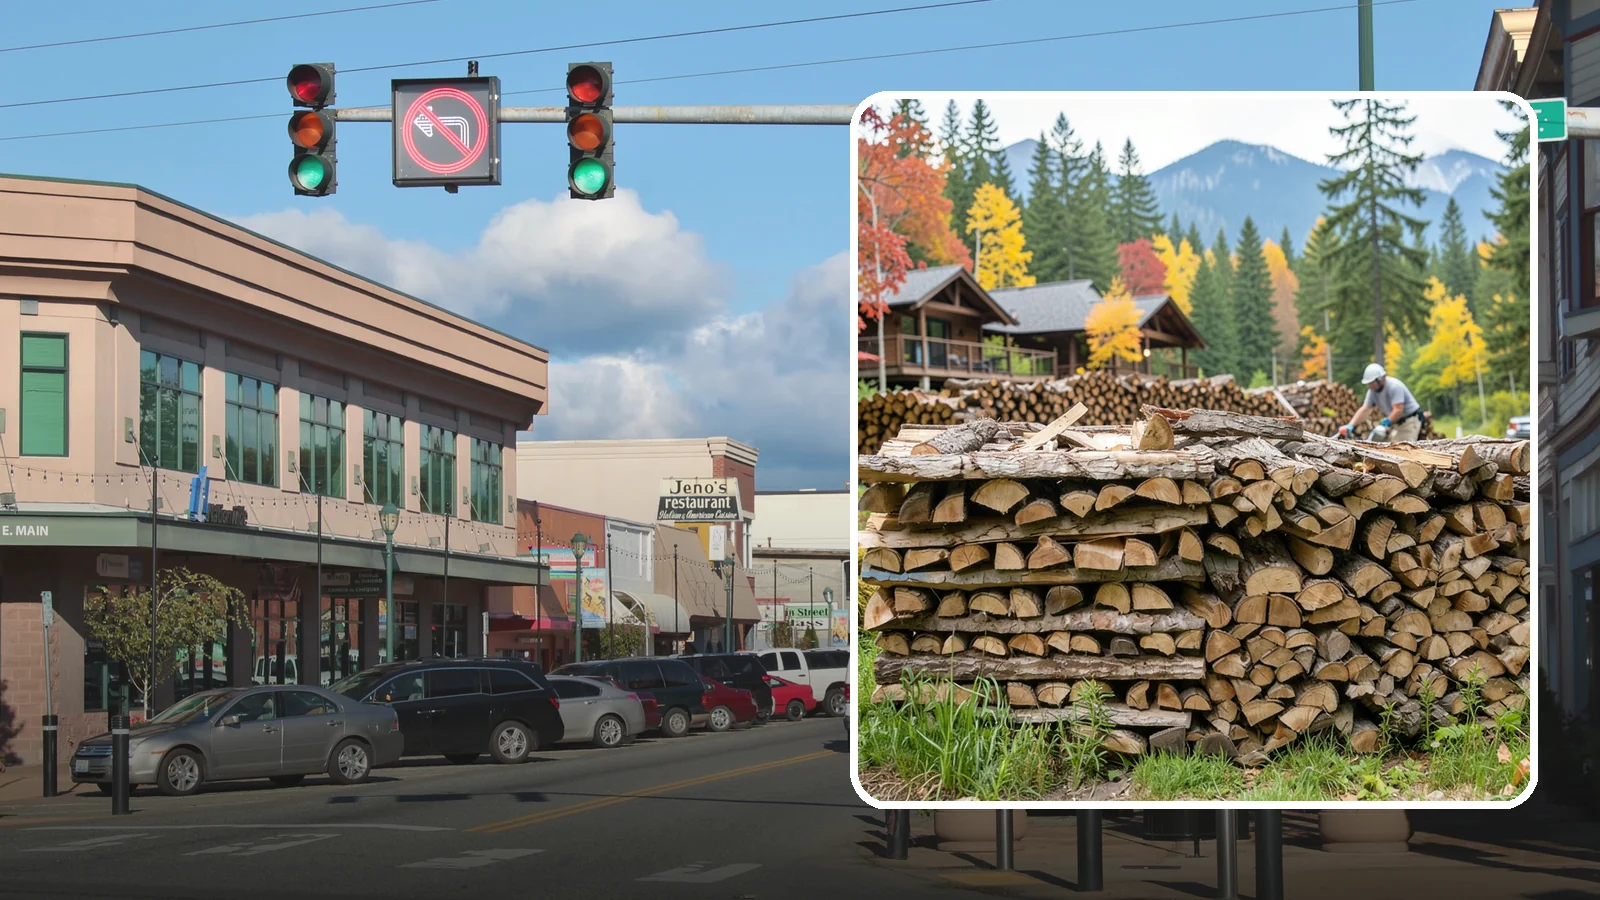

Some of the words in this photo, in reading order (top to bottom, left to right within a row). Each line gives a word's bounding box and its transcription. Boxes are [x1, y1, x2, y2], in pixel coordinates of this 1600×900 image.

[669, 480, 727, 494] Jeno's
[665, 496, 731, 509] restaurant
[658, 509, 682, 520] Italian
[686, 509, 714, 519] American
[715, 509, 737, 519] Cuisine
[2, 525, 13, 536] E.
[15, 525, 49, 536] MAIN
[786, 607, 795, 617] in
[797, 607, 829, 617] Street
[791, 619, 824, 627] lass
